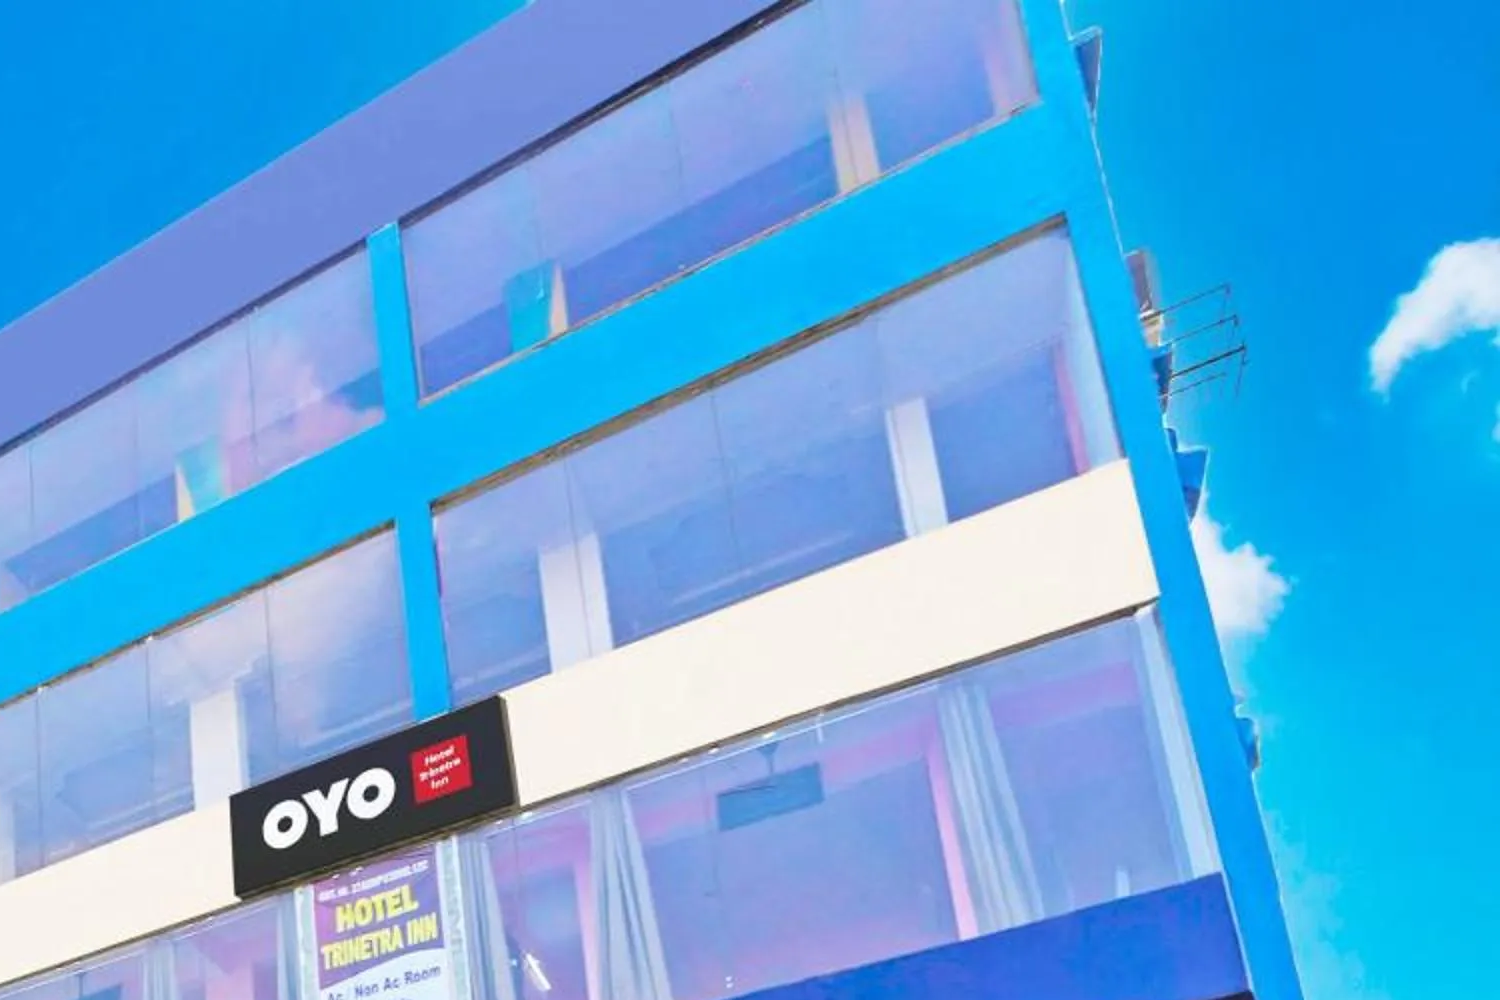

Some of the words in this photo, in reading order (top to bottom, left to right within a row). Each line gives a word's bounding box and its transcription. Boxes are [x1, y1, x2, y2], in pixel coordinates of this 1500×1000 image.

[262, 767, 396, 849] OYO
[336, 884, 419, 933] HOTEL
[320, 924, 404, 970] TRINETRA
[406, 912, 437, 946] INN
[354, 983, 379, 998] Non
[383, 977, 401, 991] Ac
[404, 966, 441, 984] Room
